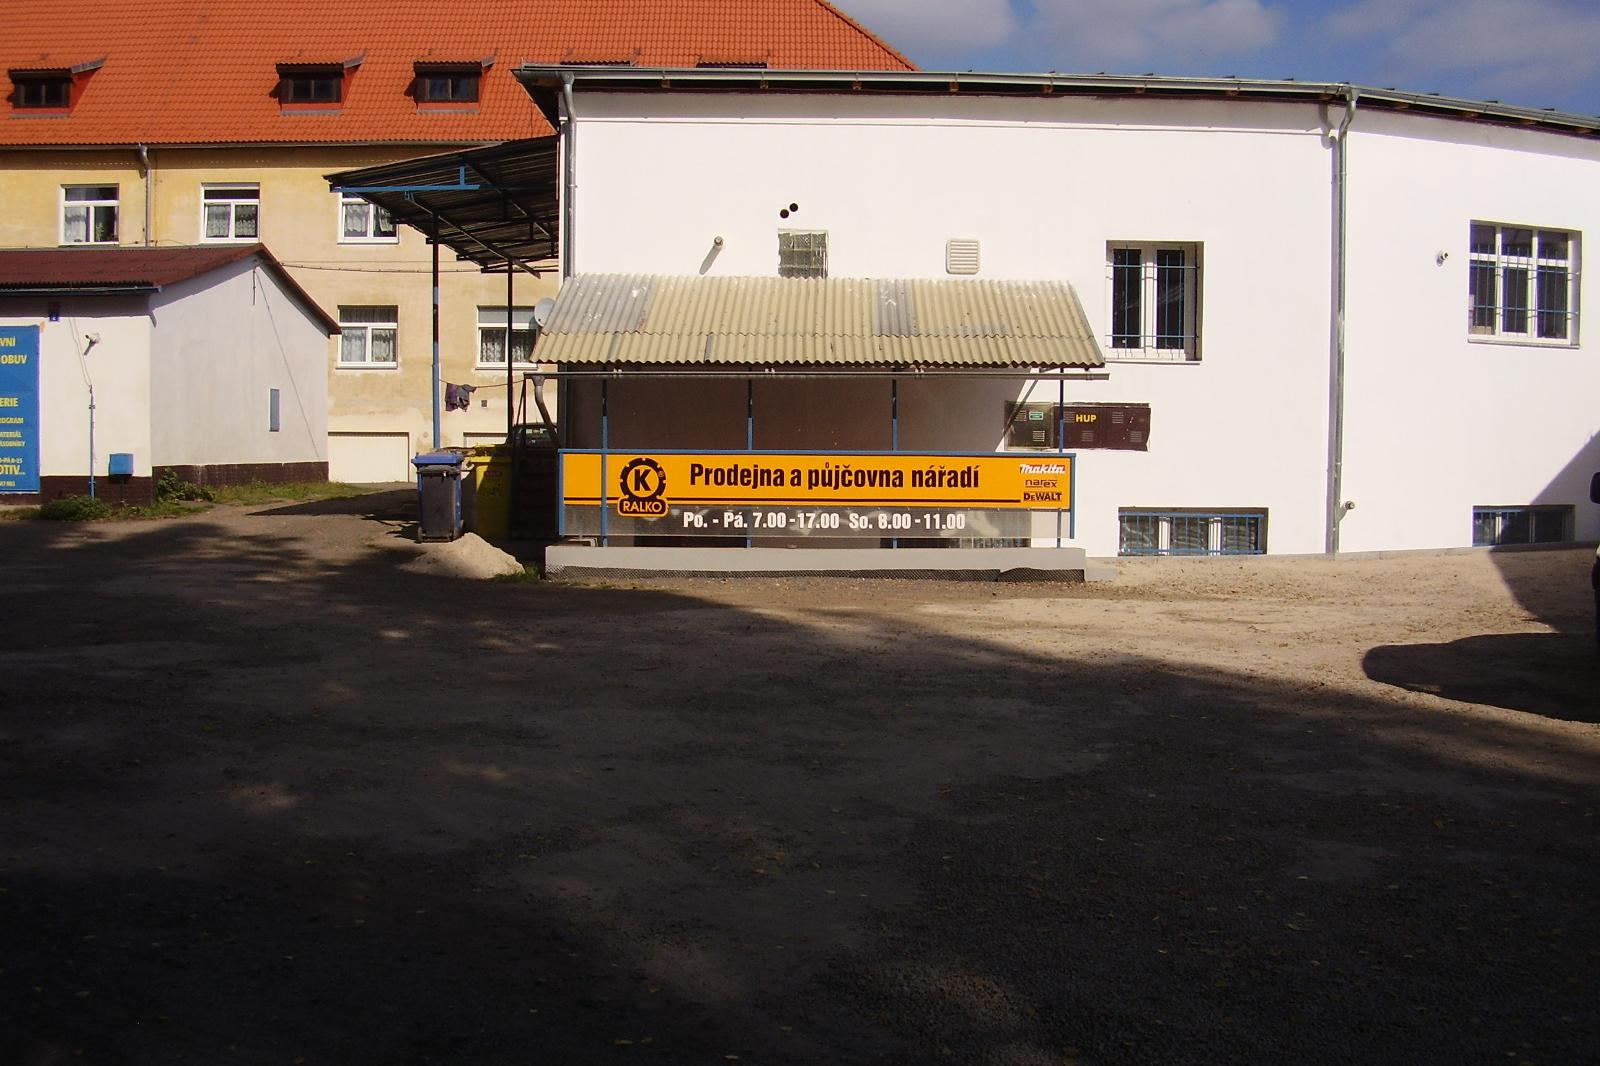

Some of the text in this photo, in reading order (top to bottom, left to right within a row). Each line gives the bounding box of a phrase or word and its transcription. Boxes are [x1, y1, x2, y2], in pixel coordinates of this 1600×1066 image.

[1, 354, 27, 365] OBUV
[1075, 414, 1097, 423] HUP
[634, 469, 652, 492] K
[690, 461, 980, 491] Prodejna a půjčovna nářadí
[1025, 479, 1058, 489] narex
[622, 501, 663, 513] RALKO
[683, 511, 708, 529] Po.
[723, 511, 748, 529] Pá.
[848, 512, 873, 530] So.
